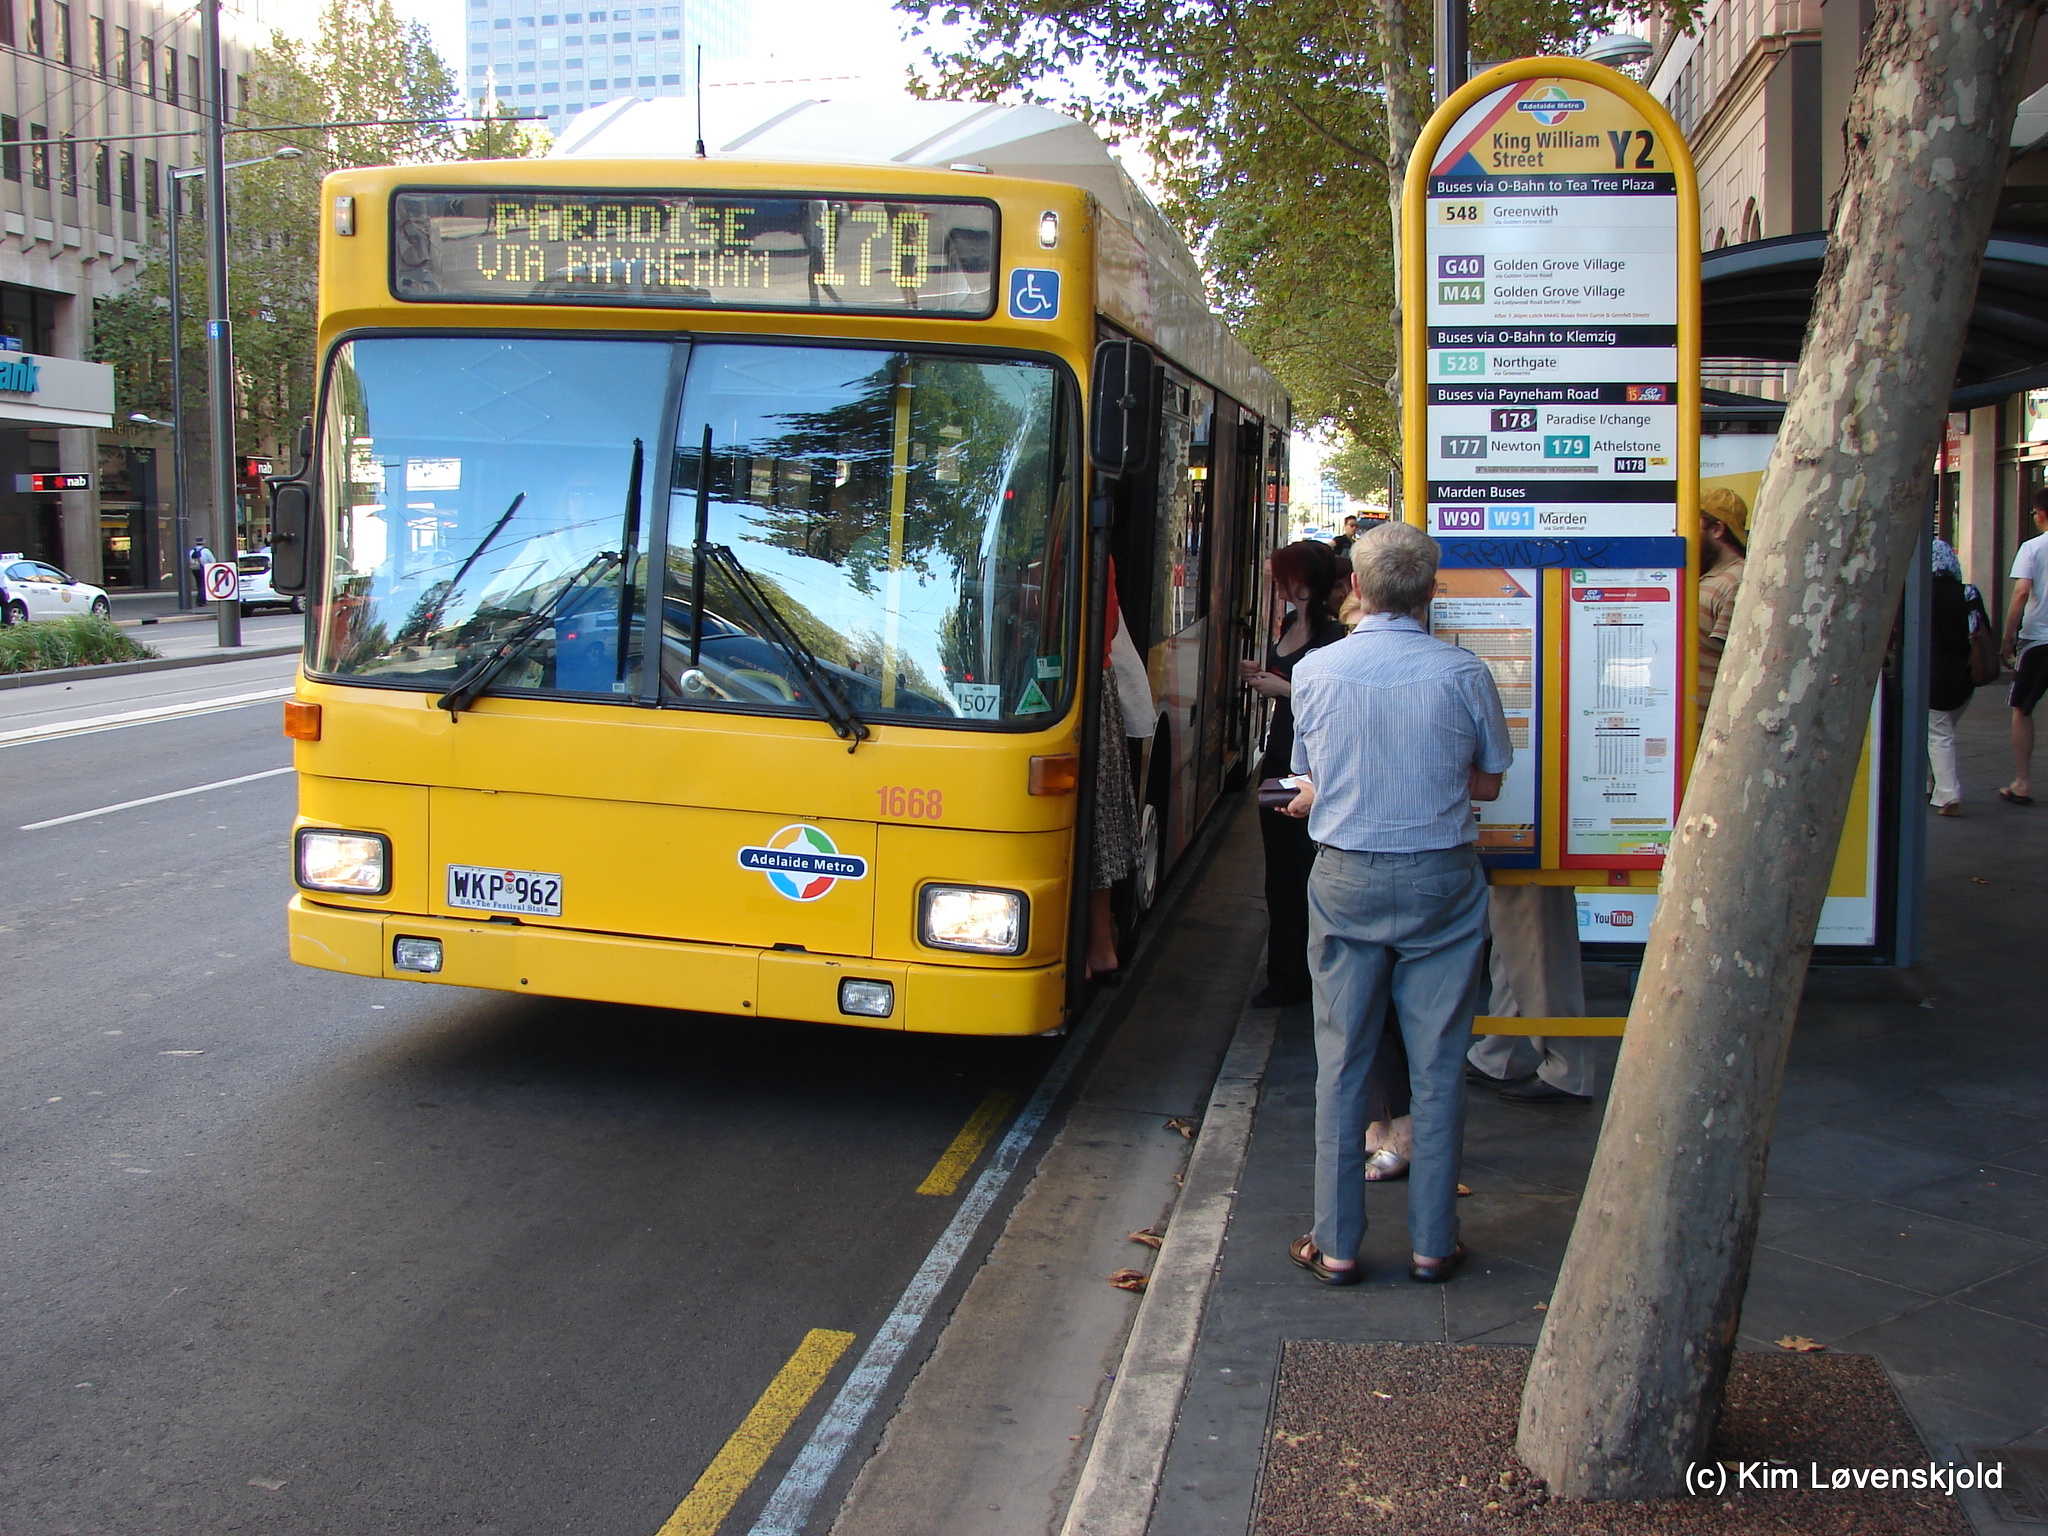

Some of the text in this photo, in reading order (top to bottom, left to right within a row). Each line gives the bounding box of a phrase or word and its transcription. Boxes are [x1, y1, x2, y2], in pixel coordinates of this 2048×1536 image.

[1493, 131, 1600, 152] King William
[1608, 130, 1654, 169] Y2
[1493, 151, 1543, 168] Street
[1437, 179, 1655, 193] Buses via O-Bahn to Tea Tree Plaza
[1446, 206, 1477, 221] 548
[1493, 205, 1558, 217] Greenwith
[494, 202, 757, 247] PARADISE
[813, 209, 929, 288] 178
[476, 243, 771, 289] VIA PAYNEHAM
[1445, 259, 1479, 274] G40
[1493, 259, 1626, 273] Golden Grove Village
[1443, 286, 1481, 301] M44
[1493, 286, 1626, 300] Golden Grove Village
[1437, 331, 1616, 345] Buses via O-Bahn to Klemzig
[1446, 356, 1479, 371] 528
[1493, 357, 1557, 371] Northgate
[1437, 389, 1599, 403] Buses via Payneham Road
[1628, 389, 1637, 401] 15
[1638, 393, 1662, 401] ZONE
[1644, 387, 1658, 395] GO
[1498, 413, 1531, 428] 178
[1546, 414, 1651, 428] Paradise I/change
[1449, 440, 1480, 455] 177
[1491, 441, 1541, 452] Newton
[1552, 440, 1583, 455] 179
[1593, 441, 1661, 452] Athelstone
[258, 462, 272, 475] nab
[1617, 460, 1644, 471] N178
[67, 476, 86, 487] nab
[1438, 487, 1526, 498] Marden Buses
[1443, 512, 1480, 527] W90
[1493, 511, 1531, 526] W91
[1539, 513, 1587, 524] Marden
[876, 786, 942, 820] 1668
[750, 853, 855, 873] Adelaide Metro
[454, 870, 558, 907] WKP 962
[493, 901, 526, 911] Festival
[527, 904, 549, 913] State
[1594, 912, 1633, 924] YouTube
